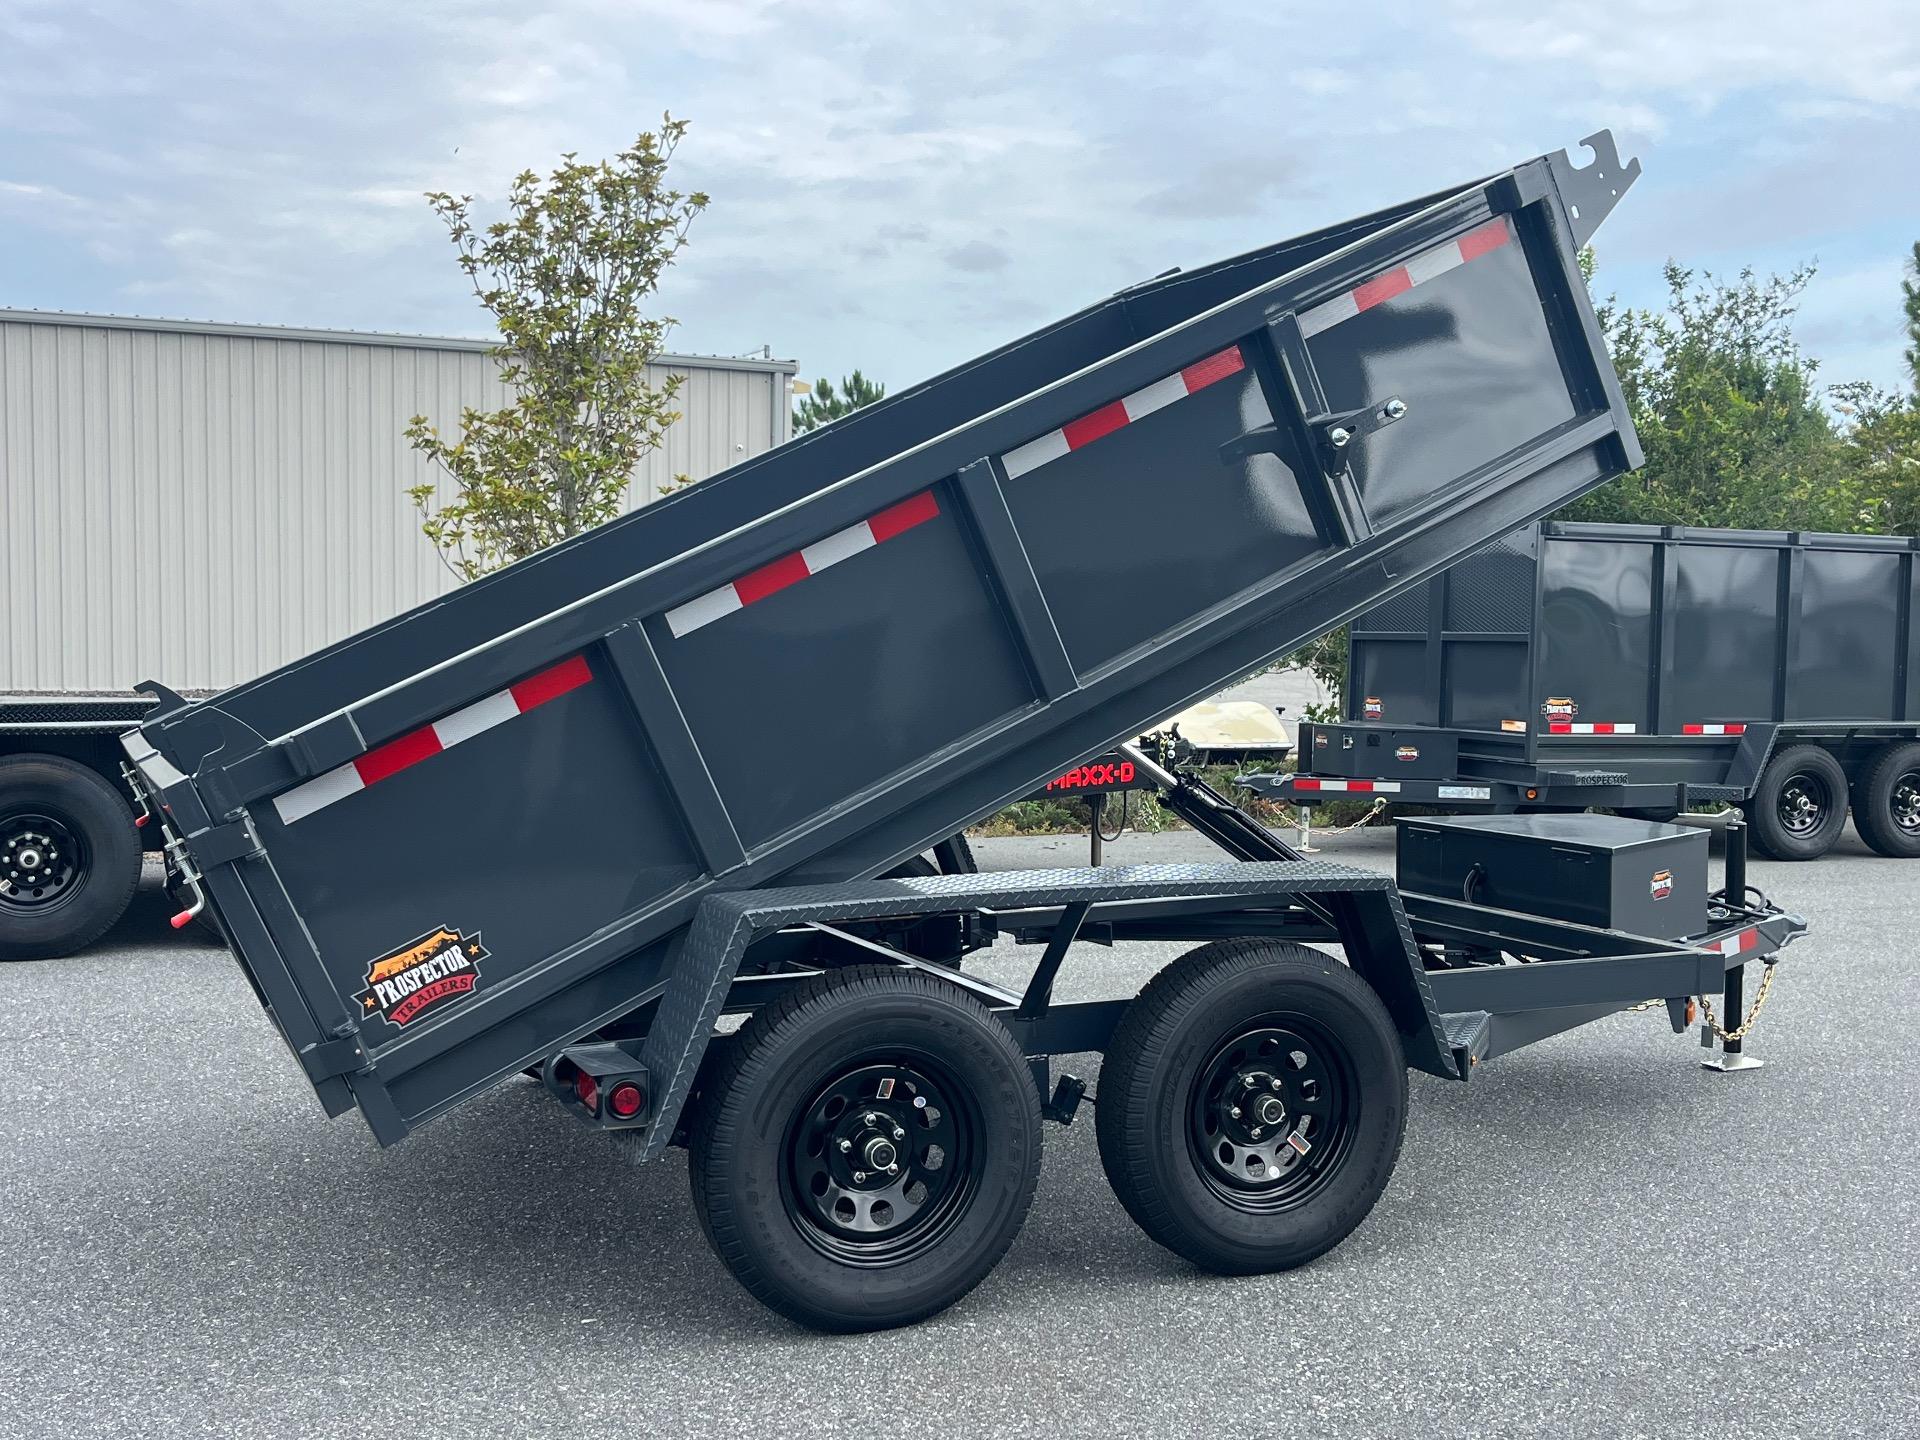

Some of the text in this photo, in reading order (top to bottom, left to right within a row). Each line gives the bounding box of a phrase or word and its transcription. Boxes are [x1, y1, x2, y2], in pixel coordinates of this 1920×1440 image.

[1576, 774, 1628, 785] PROSPECTOR
[372, 944, 471, 1009] PROSPECTOR
[397, 977, 470, 1019] TRAILERS
